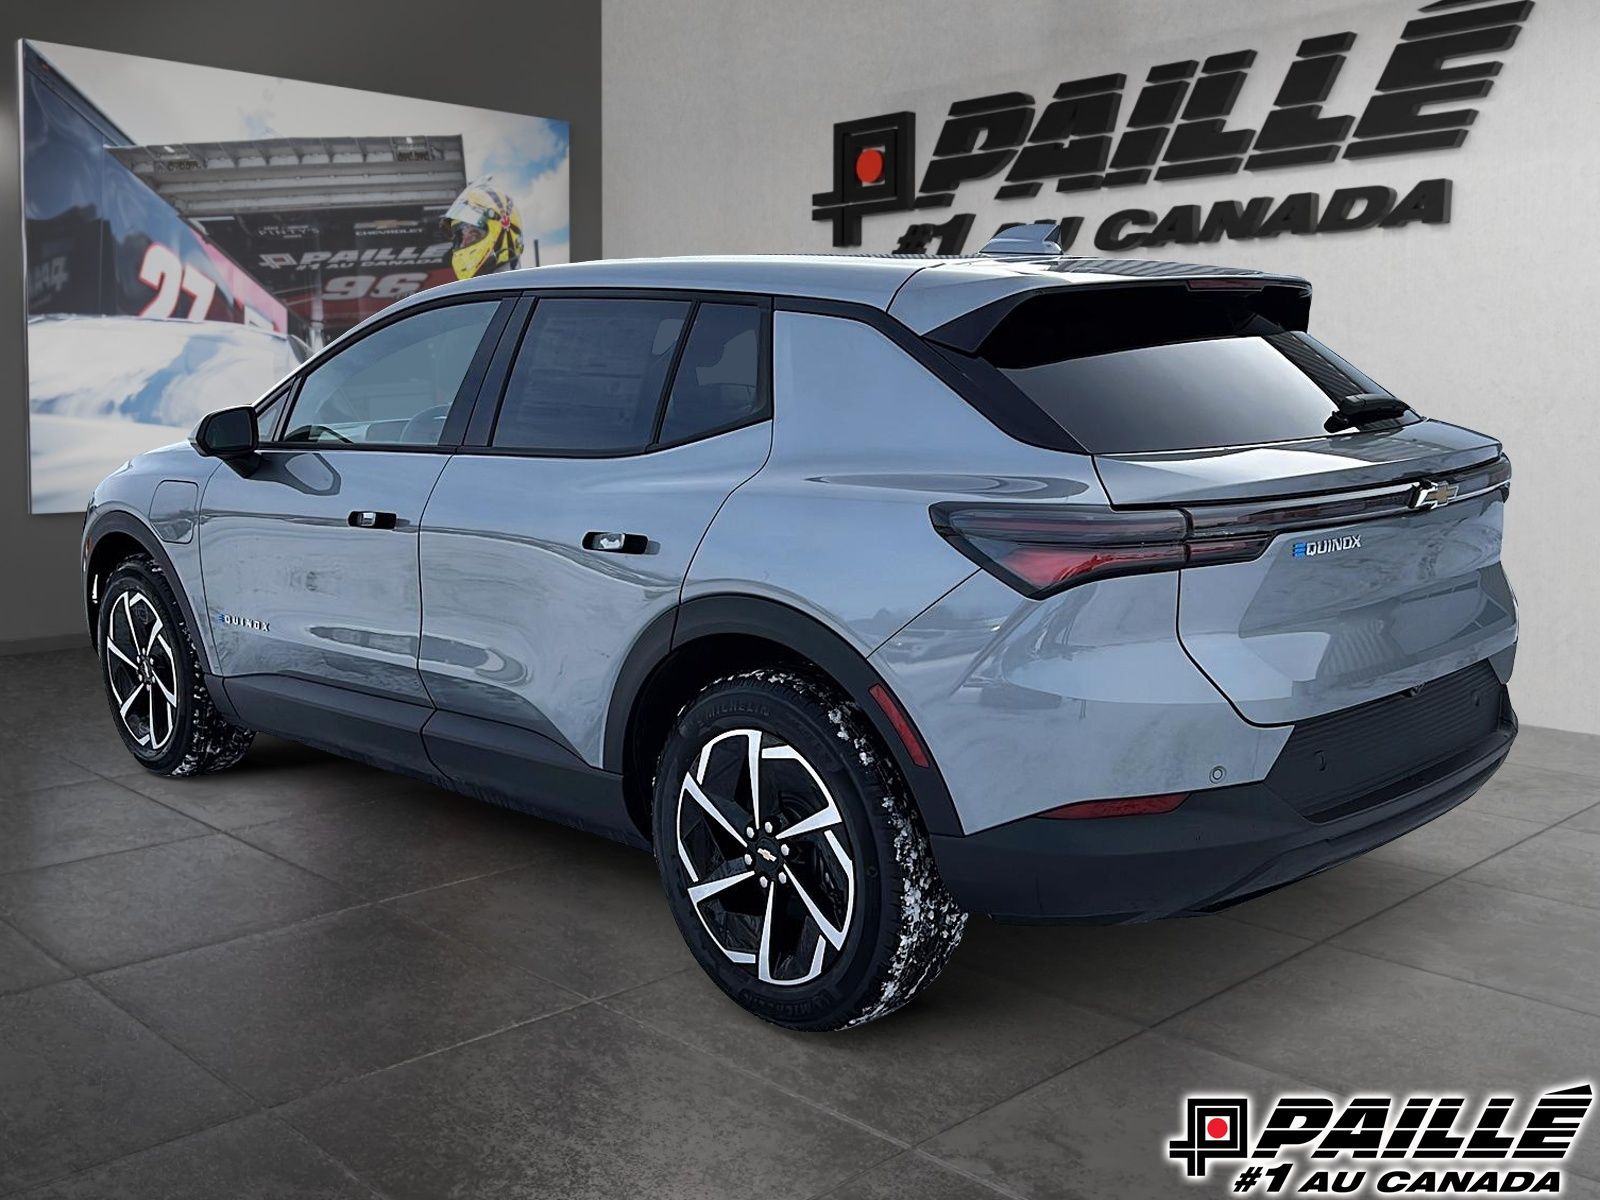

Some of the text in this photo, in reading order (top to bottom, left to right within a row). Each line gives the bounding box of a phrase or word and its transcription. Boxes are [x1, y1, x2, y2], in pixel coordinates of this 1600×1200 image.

[1095, 178, 1453, 252] CANADA
[360, 257, 443, 268] CANADA
[322, 272, 428, 301] 96
[1293, 533, 1362, 557] EQUINOX
